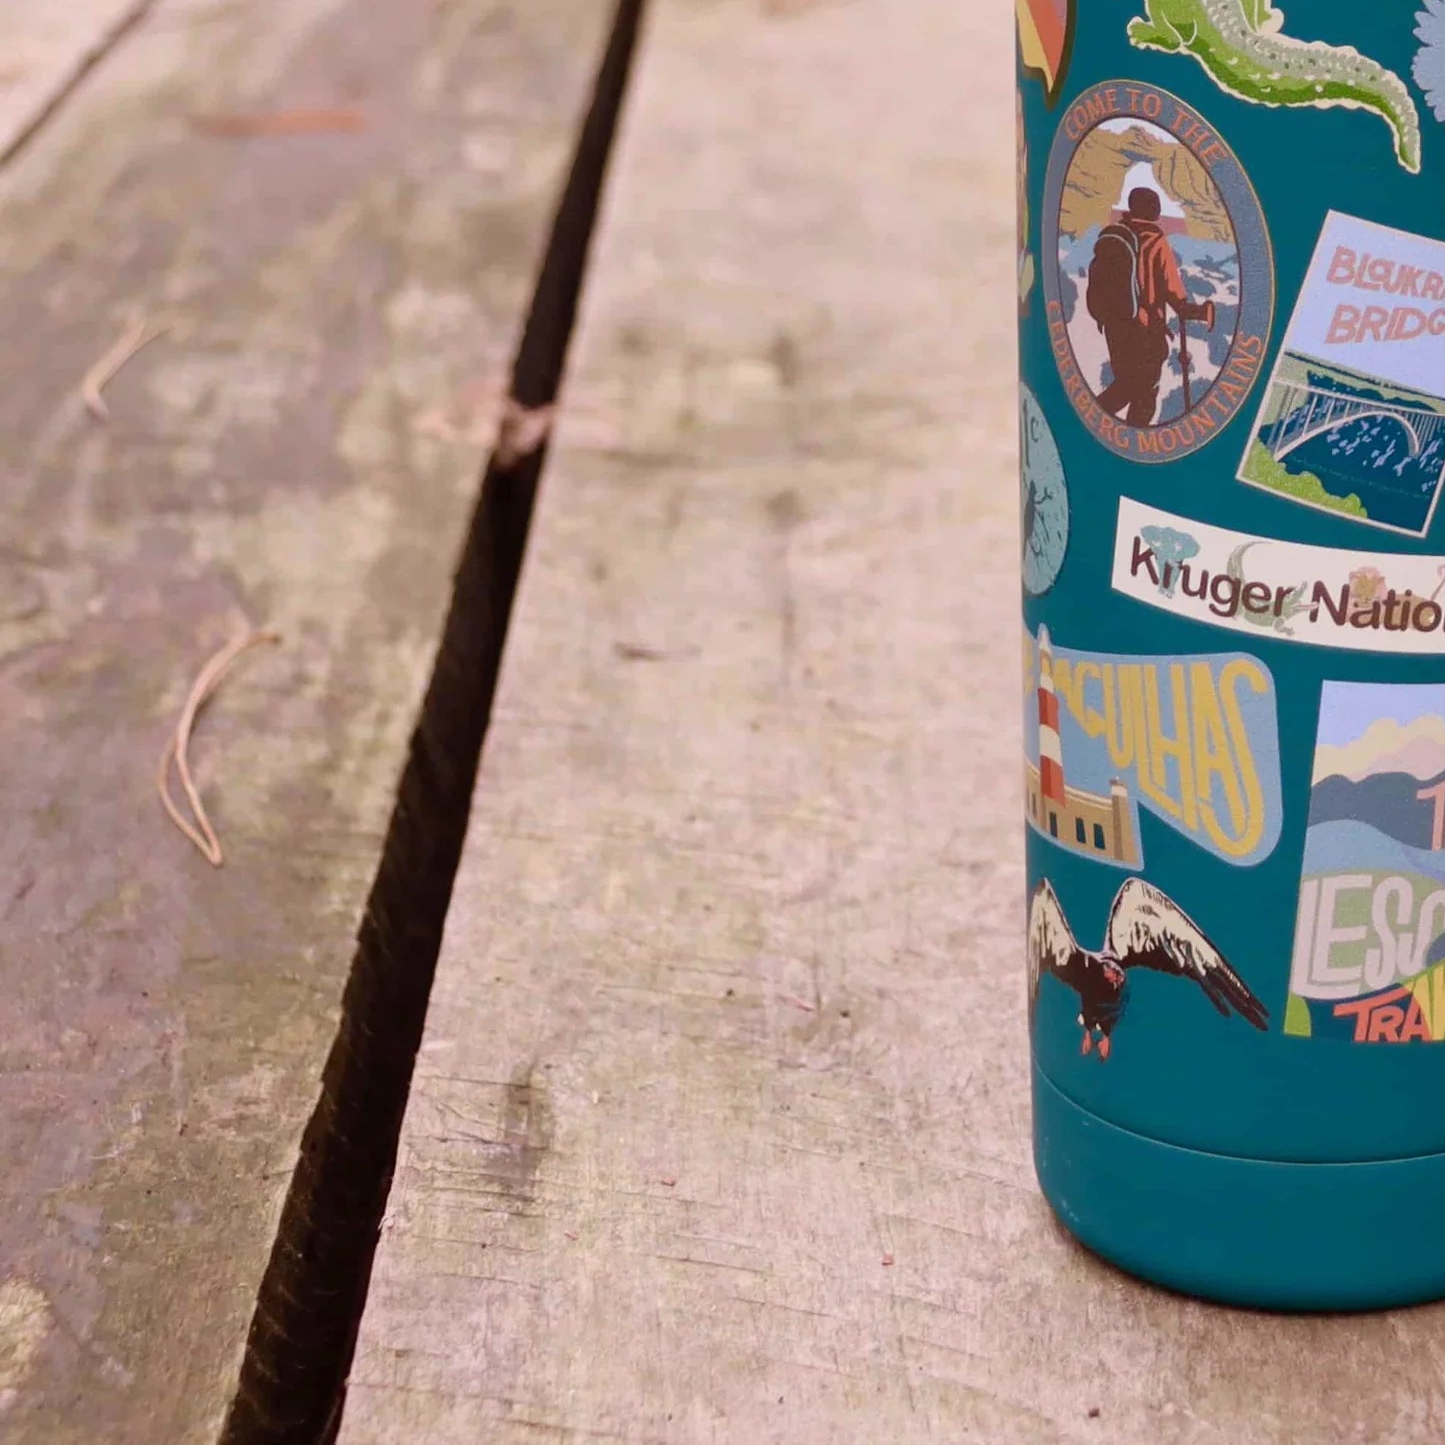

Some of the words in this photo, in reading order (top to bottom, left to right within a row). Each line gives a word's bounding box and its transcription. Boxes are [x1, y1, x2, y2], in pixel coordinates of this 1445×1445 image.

[1065, 89, 1126, 142] COME
[1126, 89, 1162, 119] TO
[1169, 101, 1230, 168] THE
[1045, 299, 1131, 453] CEDERBERG
[1134, 330, 1263, 455] MOUNTAINS
[1130, 536, 1296, 618] Kruger
